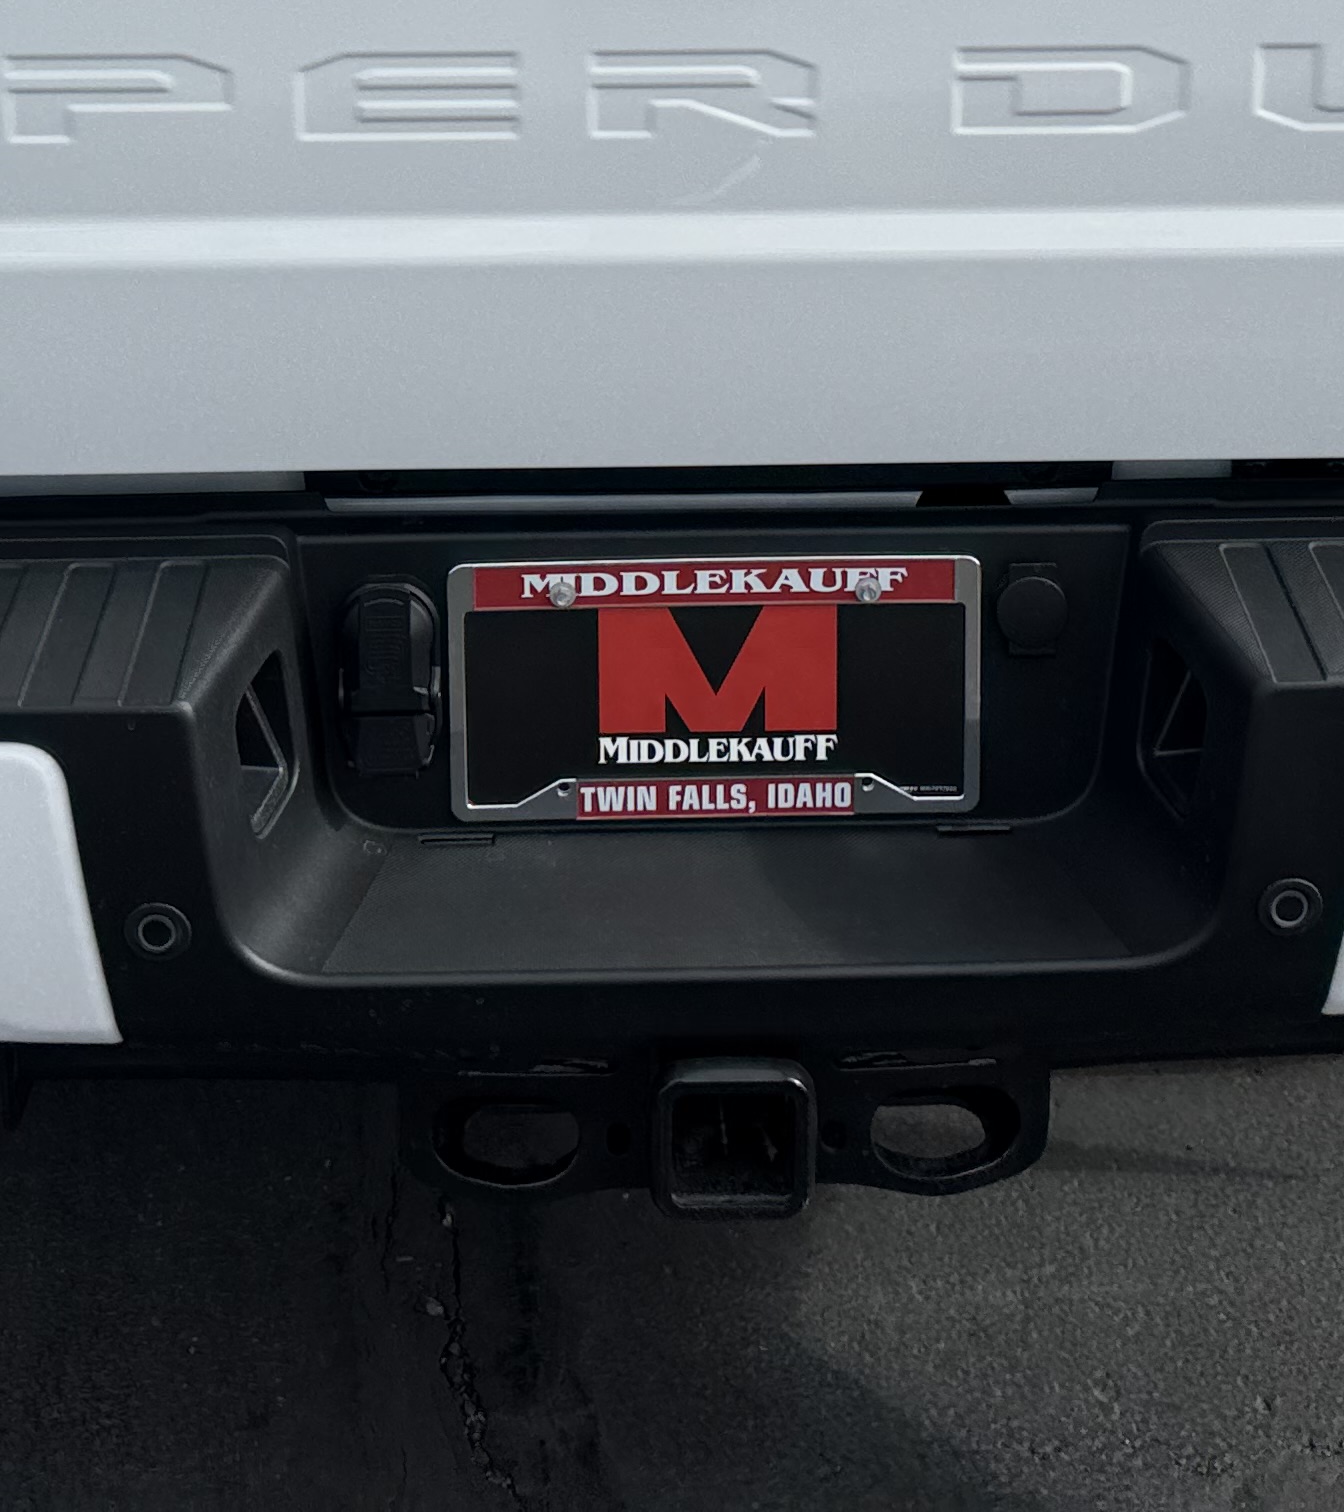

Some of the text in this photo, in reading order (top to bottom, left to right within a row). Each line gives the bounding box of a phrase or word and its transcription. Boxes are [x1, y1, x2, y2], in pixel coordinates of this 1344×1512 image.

[521, 567, 909, 599] MIDDLEKAUFF
[597, 606, 838, 734] M
[597, 734, 839, 765] MIDDLEKAUFF
[580, 781, 852, 814] TWIN FALLS, IDAHO
